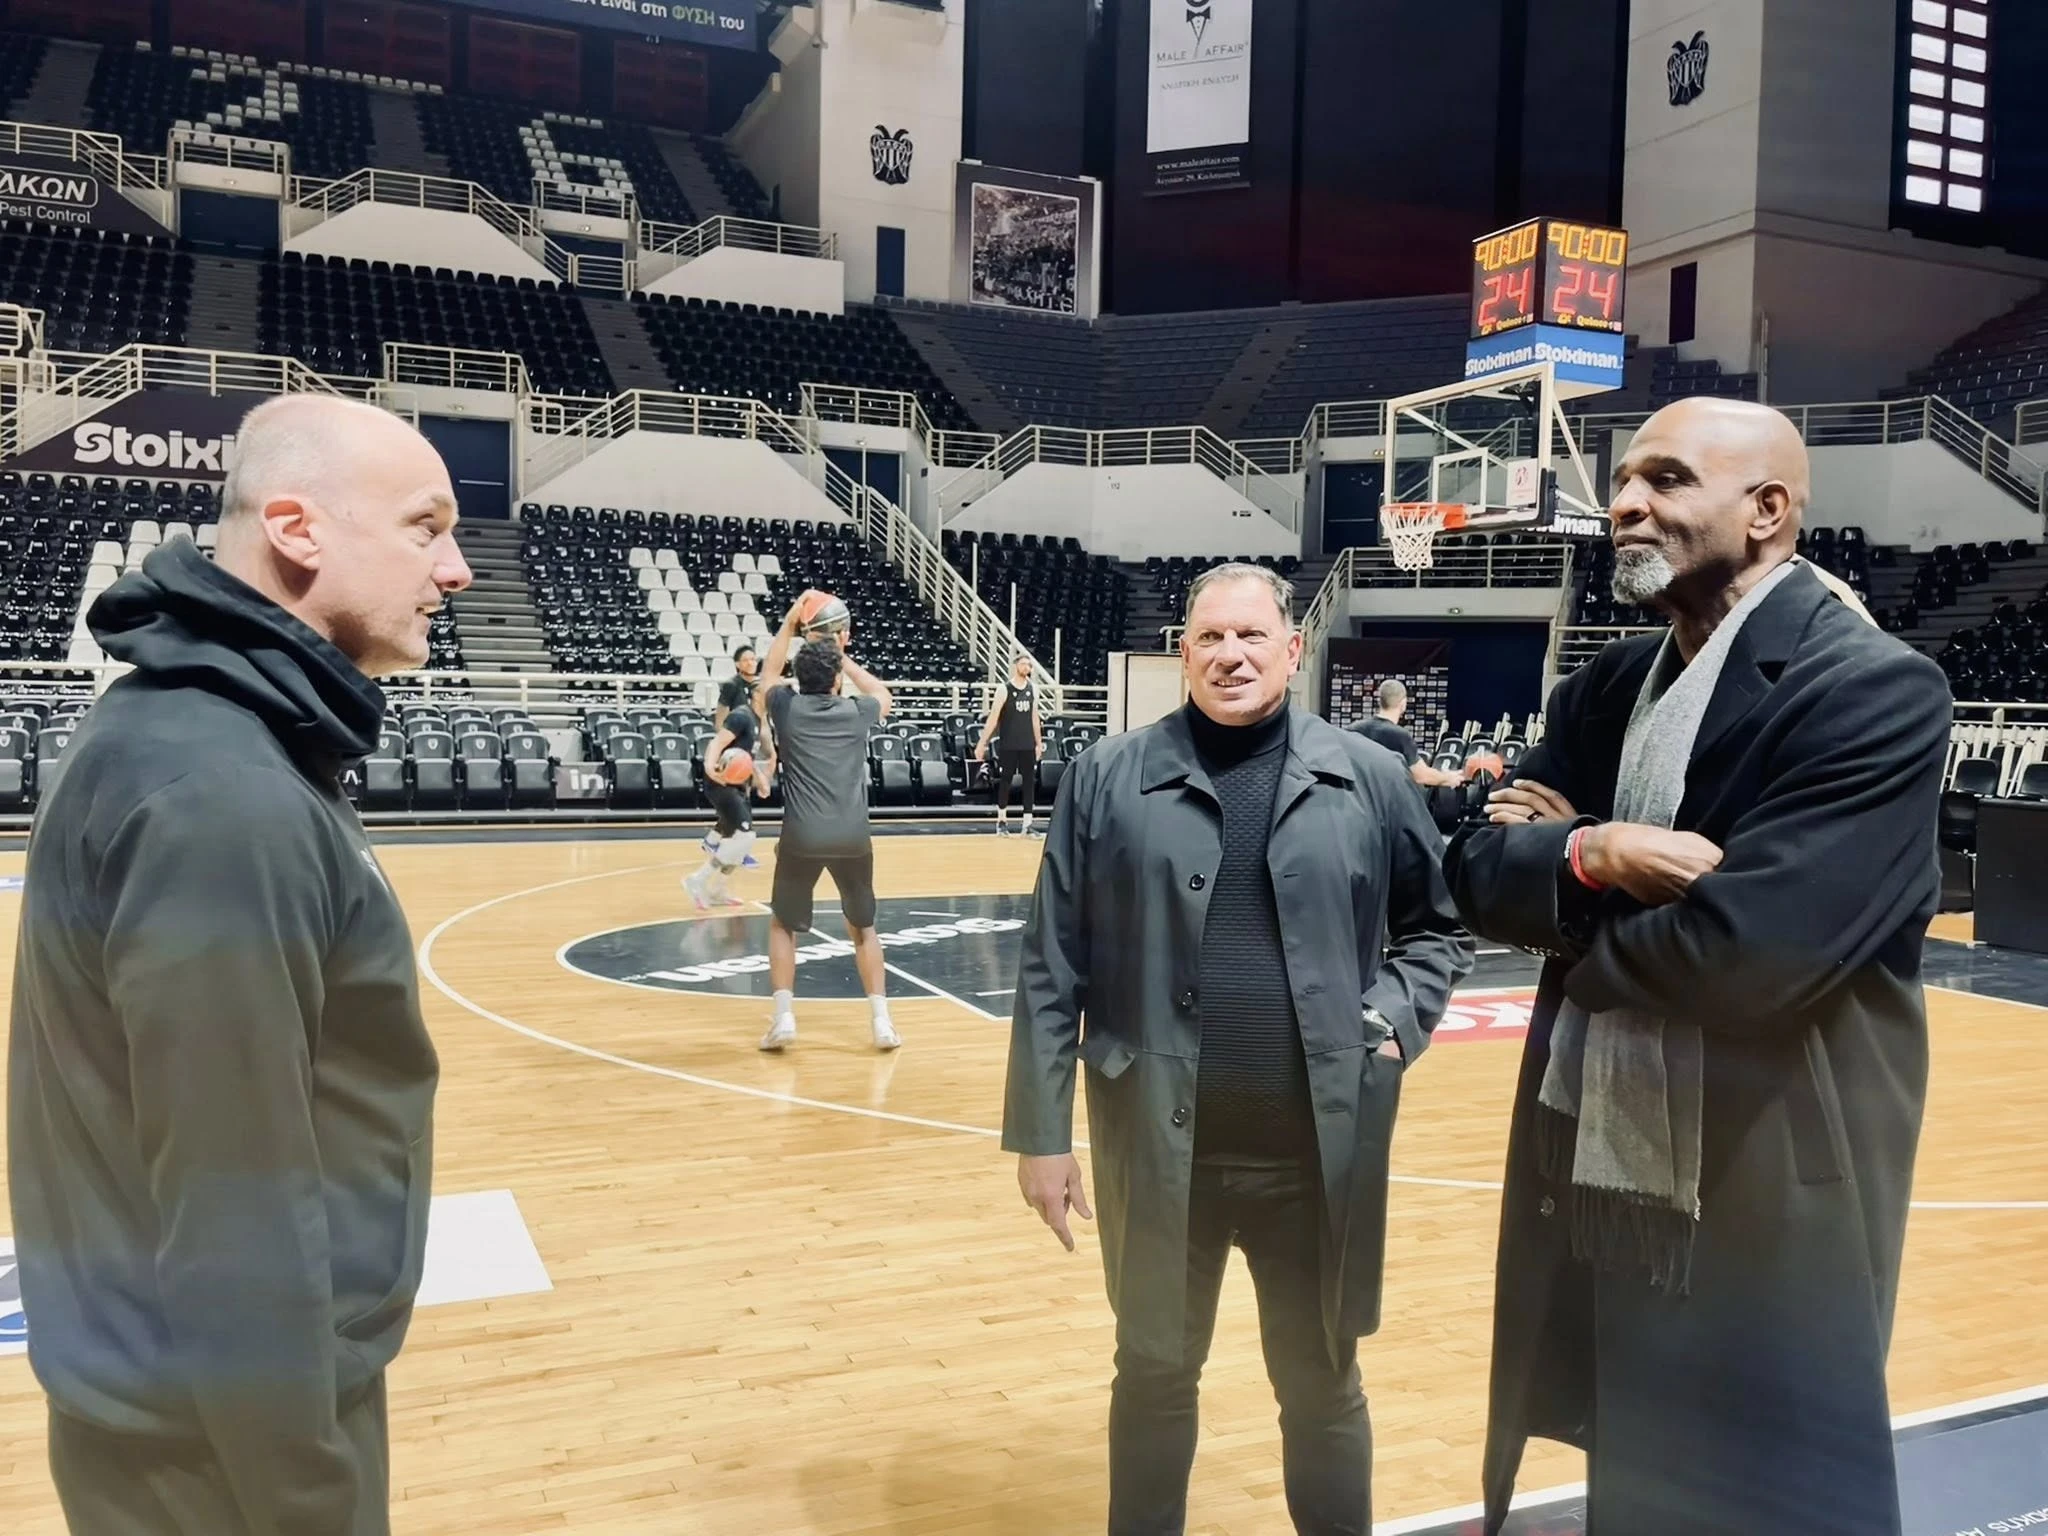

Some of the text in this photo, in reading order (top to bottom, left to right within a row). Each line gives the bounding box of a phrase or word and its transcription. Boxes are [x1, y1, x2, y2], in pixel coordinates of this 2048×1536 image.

[641, 3, 667, 18] στη
[672, 5, 715, 25] ΦΥΣΗ
[719, 15, 745, 31] του
[1157, 51, 1187, 62] MALE
[0, 201, 91, 224] Pest Control
[1475, 223, 1539, 271] 90:00
[1547, 221, 1628, 266] 90:00
[1478, 266, 1532, 327] 24
[1552, 264, 1616, 319] 24
[73, 421, 235, 472] Stoixi
